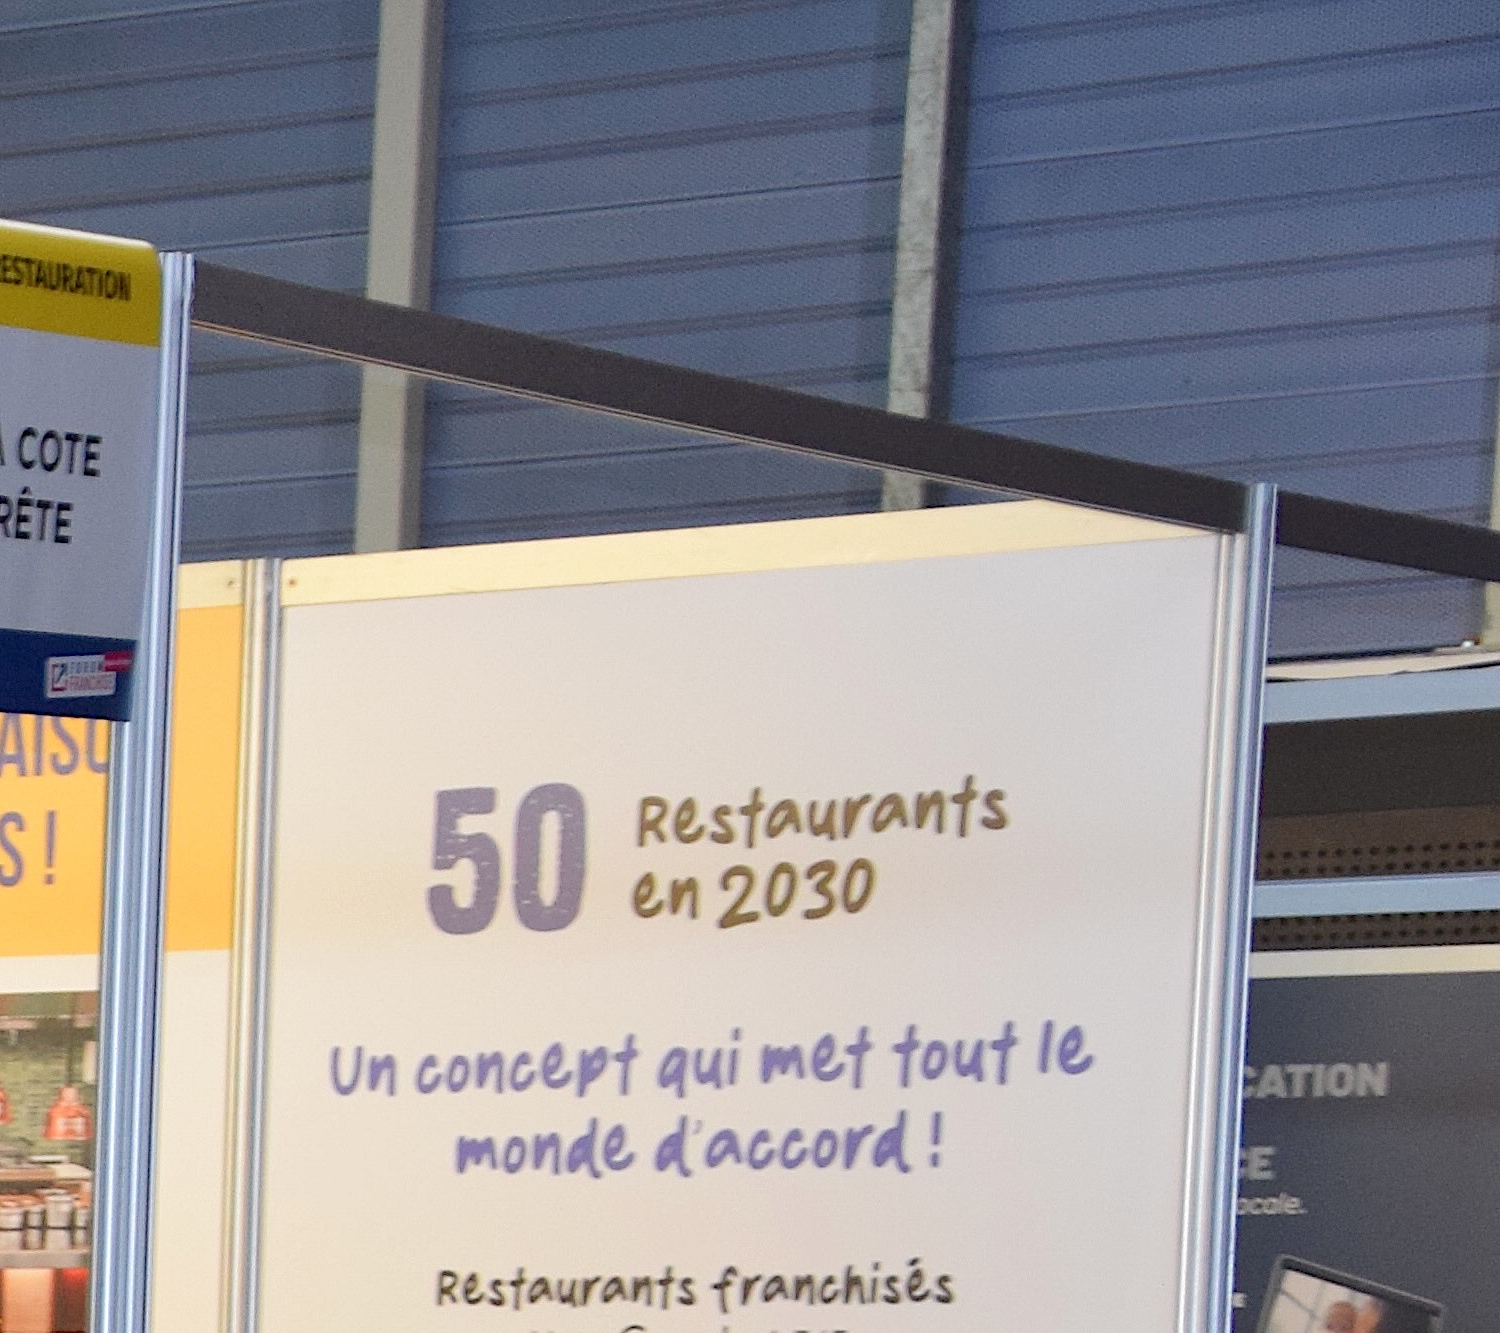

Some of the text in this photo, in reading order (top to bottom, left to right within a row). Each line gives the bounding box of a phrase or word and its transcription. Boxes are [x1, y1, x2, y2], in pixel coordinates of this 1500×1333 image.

[17, 426, 101, 478] COTE
[42, 810, 59, 885] !
[425, 774, 1011, 935] 50 Restaurants
[631, 856, 877, 931] en 2030
[329, 1018, 1096, 1100] Un concept qui met tout le
[454, 1111, 945, 1177] monde d'accord !
[436, 1258, 957, 1313] Restaurants franchisés
